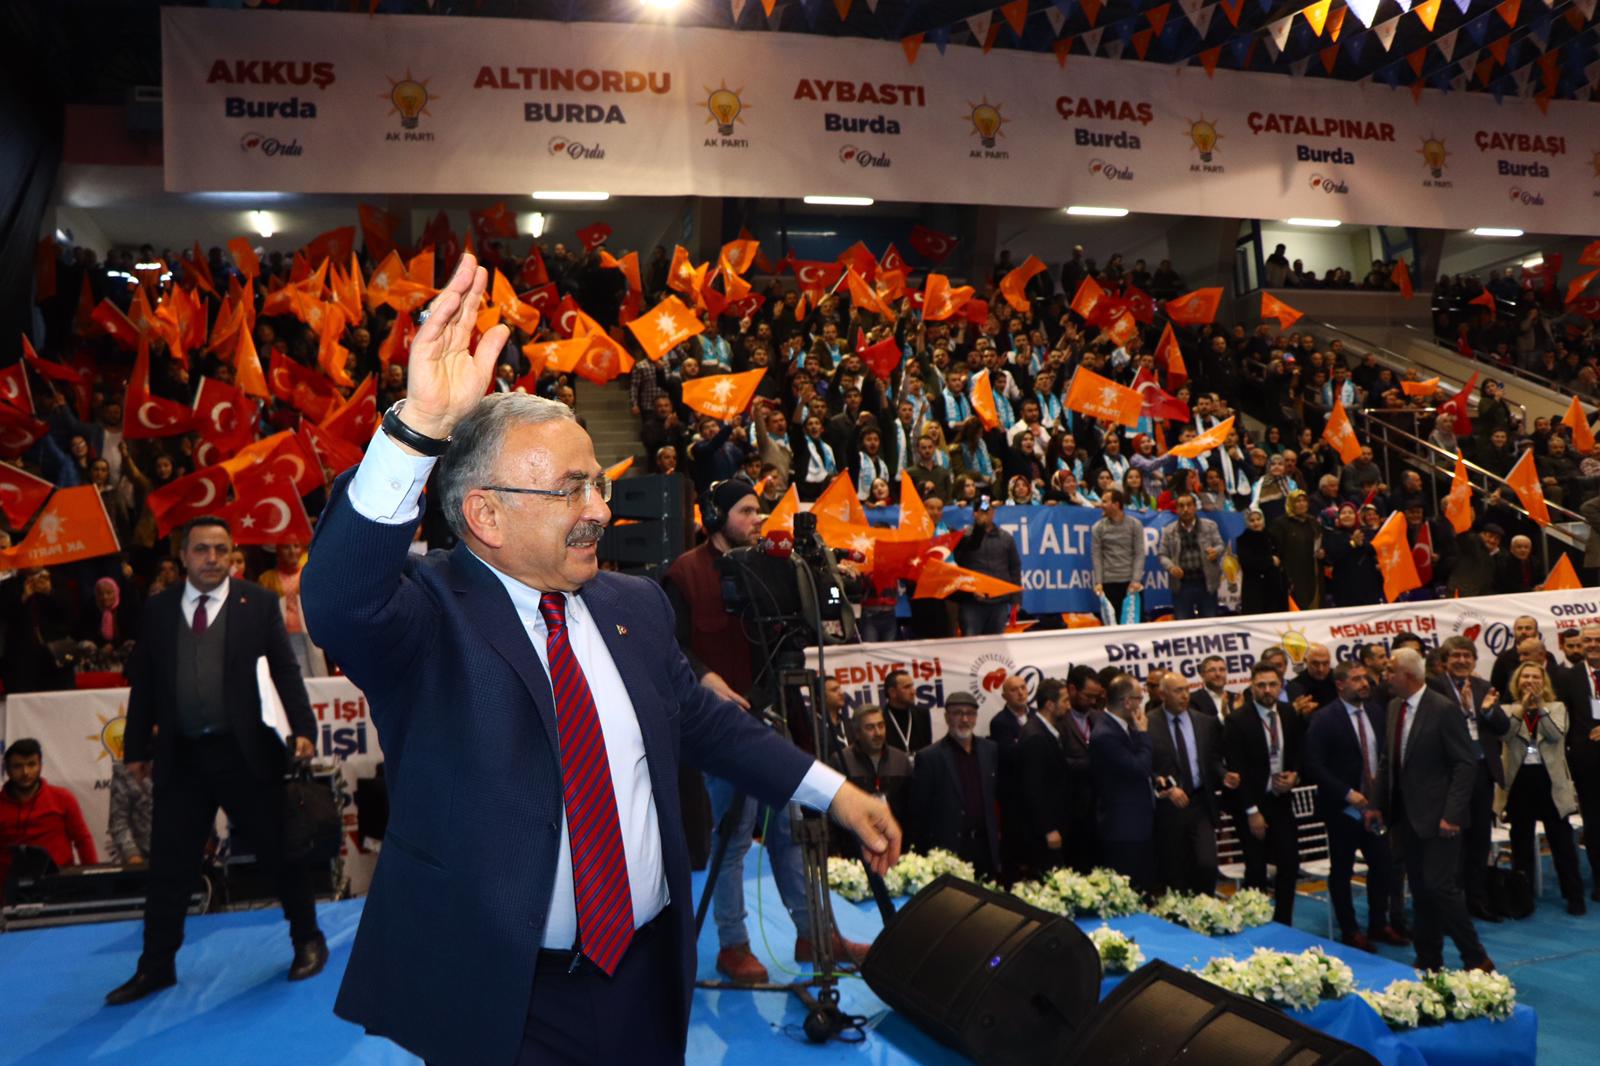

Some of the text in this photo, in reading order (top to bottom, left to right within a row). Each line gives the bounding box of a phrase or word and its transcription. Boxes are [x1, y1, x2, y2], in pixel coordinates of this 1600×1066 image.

[206, 59, 336, 90] AKKUŞ
[473, 66, 672, 95] ALTINORDU
[794, 79, 927, 107] AYBASTI
[225, 97, 317, 119] Burda
[524, 102, 626, 124] BURDA
[1056, 96, 1154, 127] ÇAMAŞ
[824, 113, 900, 135] Burda
[1247, 111, 1396, 142] ÇATALPINAR
[261, 136, 304, 157] Ordu
[385, 132, 401, 142] AK
[703, 138, 719, 148] AK
[1074, 127, 1142, 150] Burda
[1475, 130, 1566, 157] ÇAYBAŞI
[566, 140, 606, 160] Ordu
[856, 149, 892, 168] Ordu
[969, 149, 983, 159] AK
[1296, 144, 1356, 165] Burda
[1102, 163, 1135, 181] Ordu
[1497, 159, 1550, 179] Burda
[1550, 601, 1598, 617] ORDU
[1329, 618, 1413, 639] MEMLEKET
[1414, 614, 1437, 634] İŞİ
[1105, 632, 1251, 663] DR. MEHMET
[911, 656, 943, 682] İŞİ
[333, 696, 367, 723] İŞİ
[321, 721, 368, 761] İŞİ
